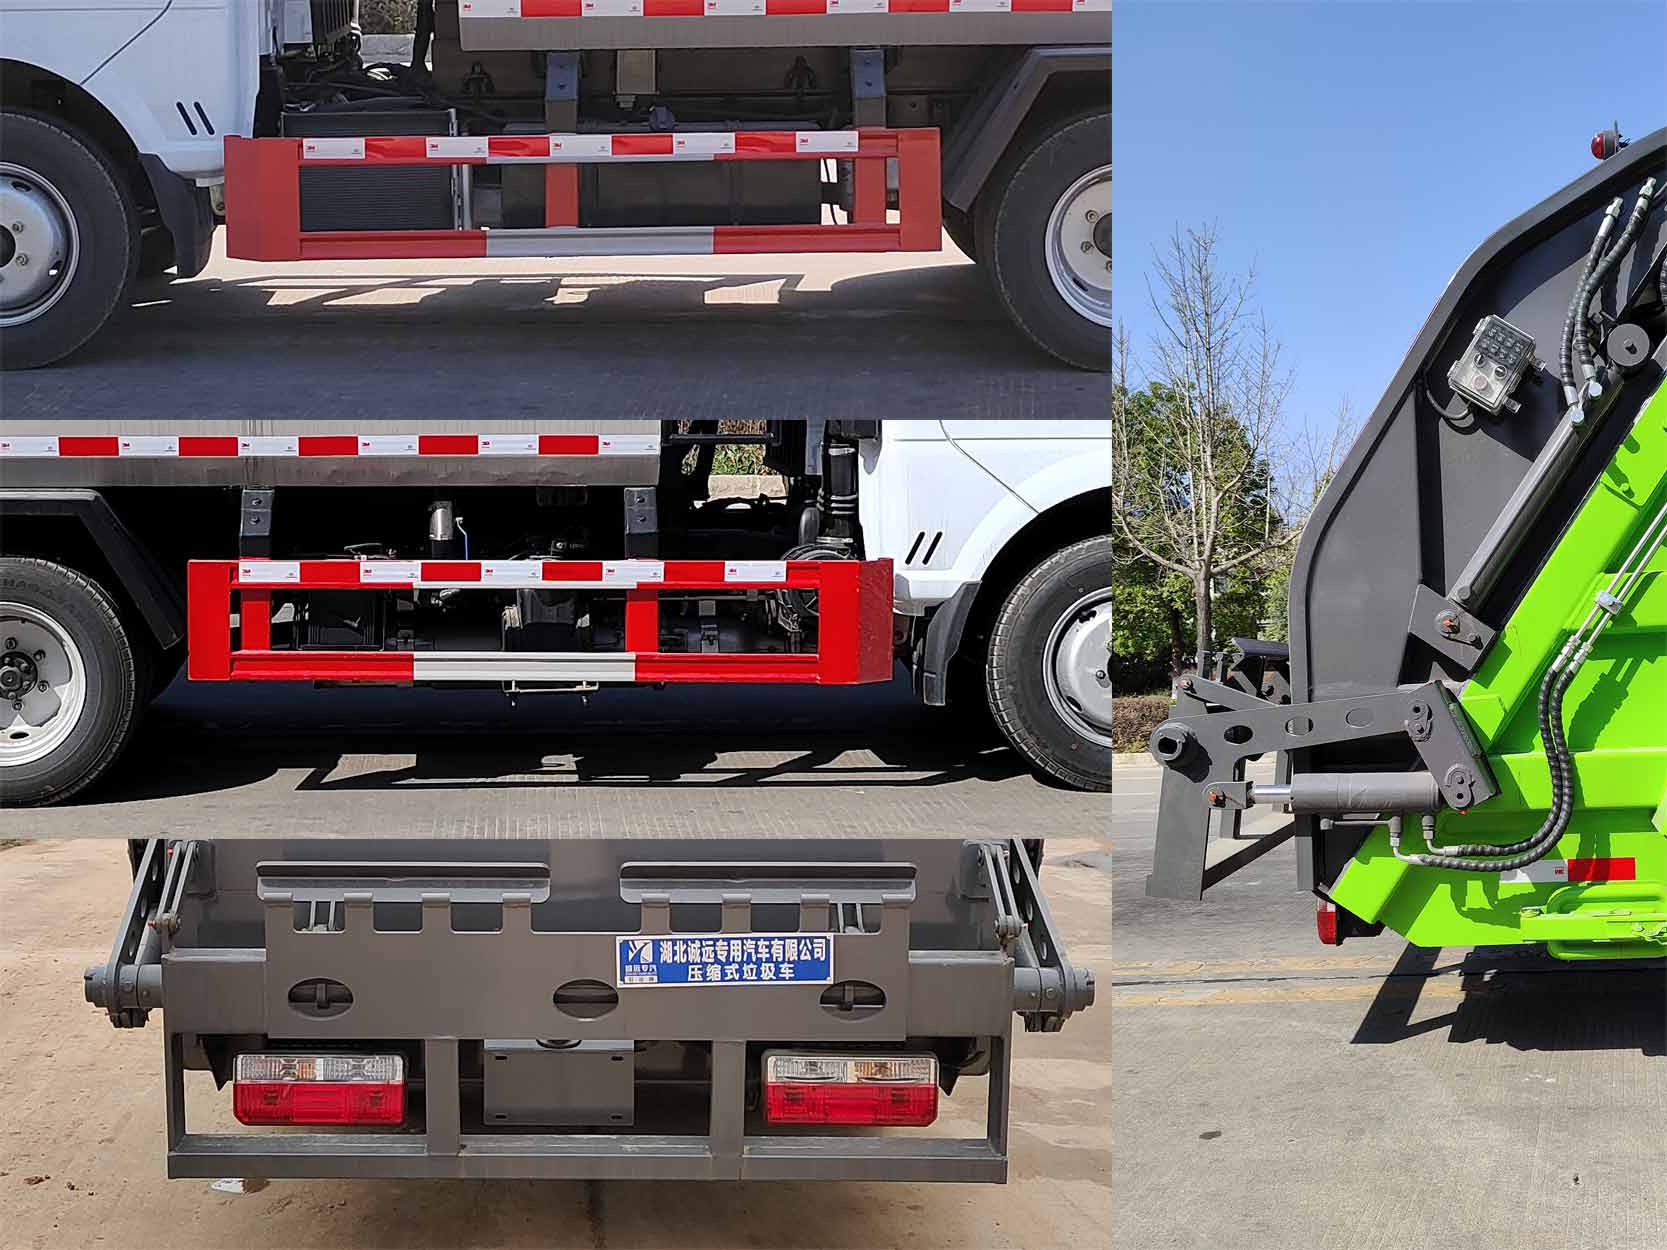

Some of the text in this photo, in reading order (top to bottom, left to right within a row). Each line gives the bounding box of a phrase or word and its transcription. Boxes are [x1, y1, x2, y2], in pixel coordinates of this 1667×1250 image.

[659, 938, 826, 963] 湖北诚远专用汽车有限公司
[687, 963, 795, 982] 压缩式垃圾车
